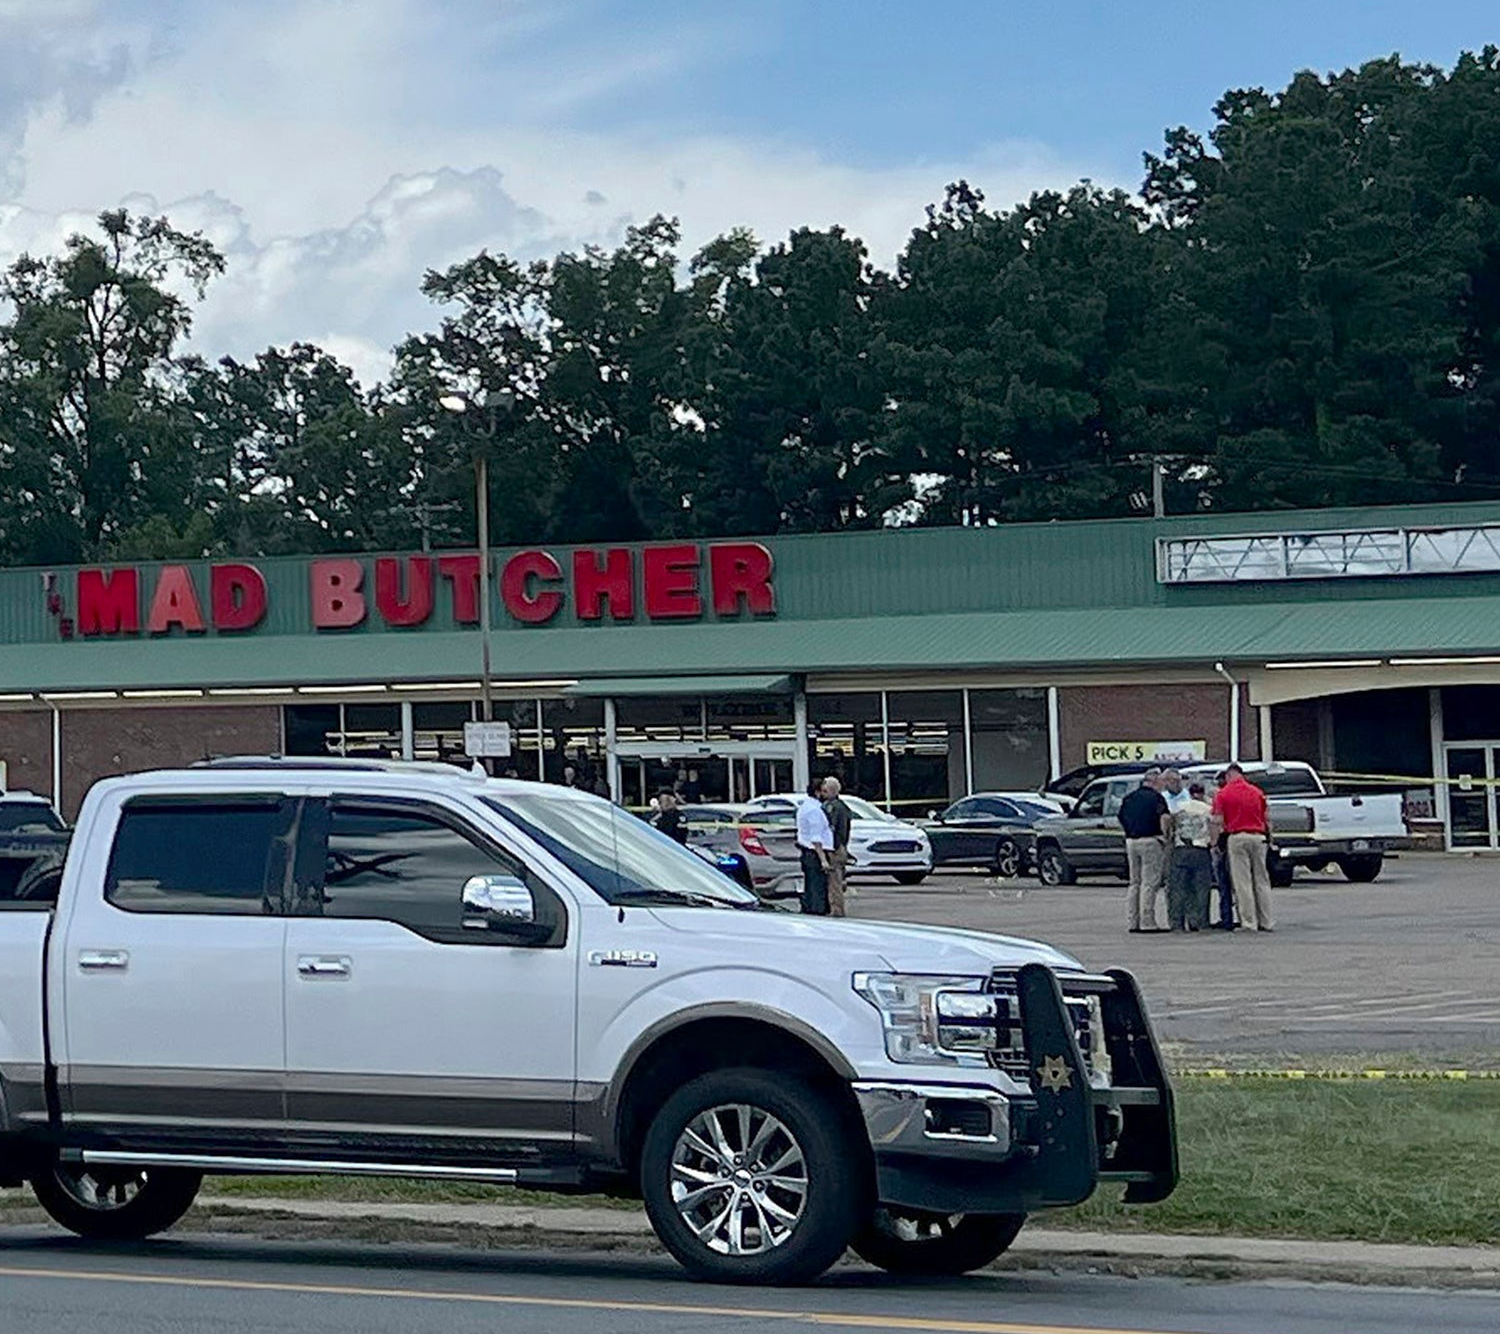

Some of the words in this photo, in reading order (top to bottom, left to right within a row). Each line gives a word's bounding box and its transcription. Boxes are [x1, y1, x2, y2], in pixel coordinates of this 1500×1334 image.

[78, 564, 269, 635] MAD
[312, 542, 777, 631] BUTCHER
[1091, 746, 1130, 760] PICK
